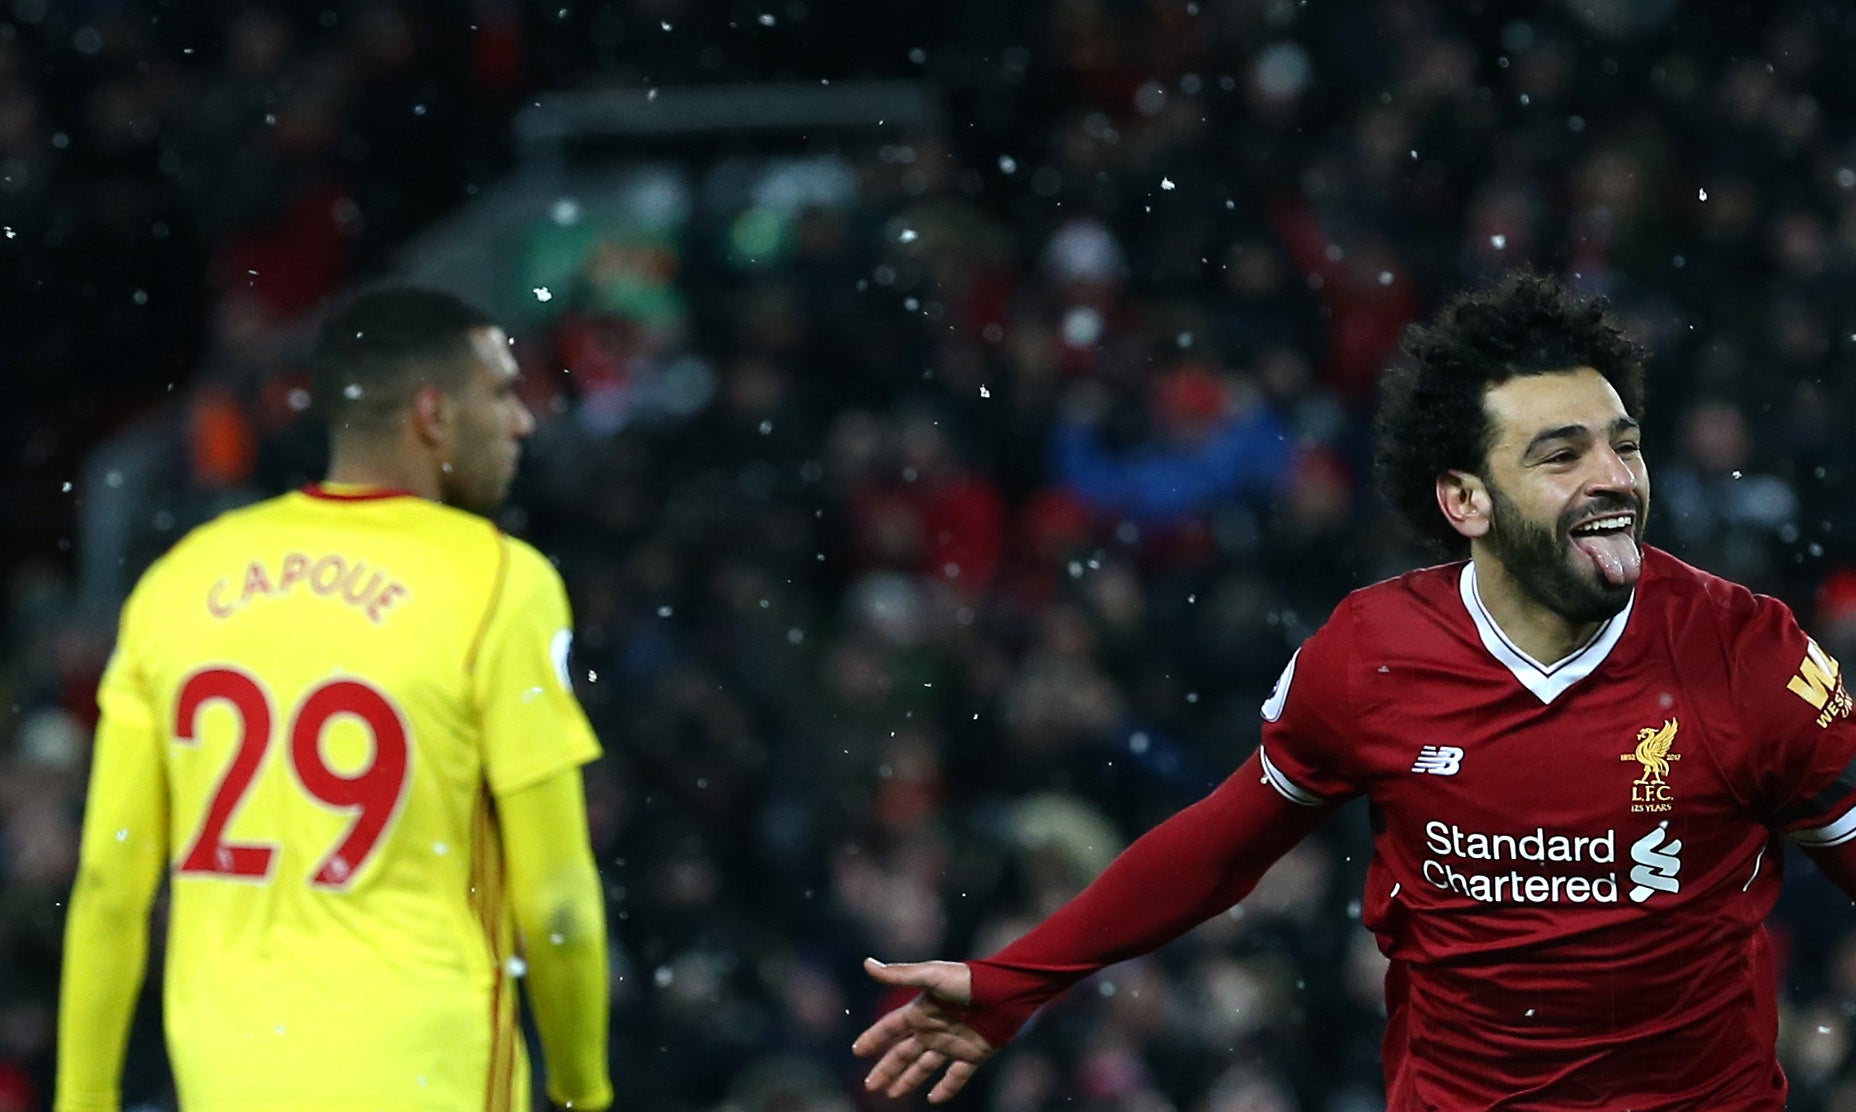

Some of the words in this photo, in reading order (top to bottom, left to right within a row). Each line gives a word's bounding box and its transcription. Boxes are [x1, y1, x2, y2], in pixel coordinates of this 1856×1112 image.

[207, 551, 407, 624] CAPOUE
[172, 666, 412, 888] 29
[1631, 785, 1675, 802] L.F.C.
[1425, 820, 1615, 863] Standard
[1423, 859, 1618, 903] Chartered
